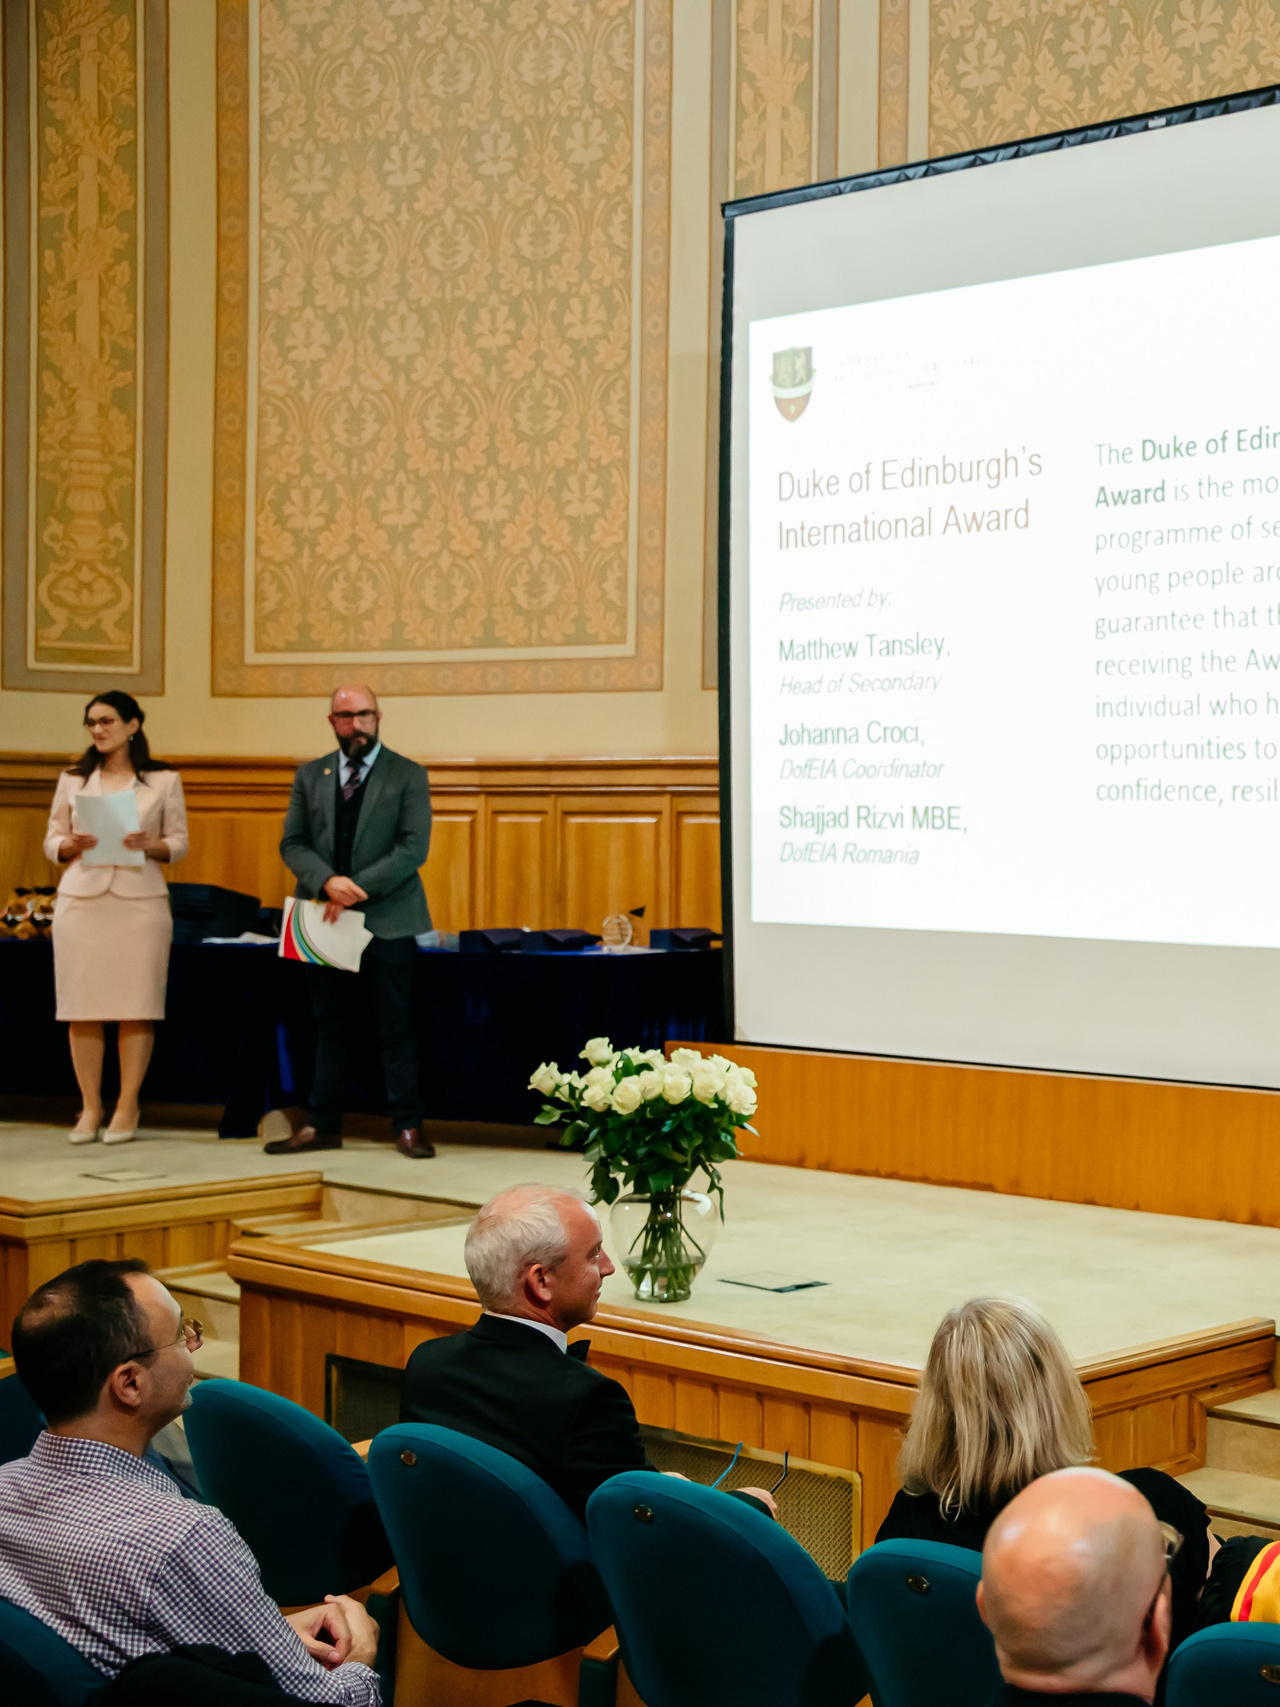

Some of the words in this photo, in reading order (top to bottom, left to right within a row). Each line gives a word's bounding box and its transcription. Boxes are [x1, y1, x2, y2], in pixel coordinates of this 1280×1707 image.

[1095, 443, 1133, 466] The
[1142, 435, 1197, 462] Duke
[1205, 430, 1229, 455] of
[778, 469, 839, 501] Duke
[849, 462, 872, 493] of
[882, 446, 1043, 490] Edinburgh's
[1095, 479, 1165, 508] Award
[1174, 478, 1190, 501] is
[1197, 475, 1234, 499] the
[779, 507, 932, 550] International
[942, 498, 1029, 536] Award
[1096, 525, 1223, 555] programme
[1231, 515, 1253, 540] of
[1095, 572, 1160, 597] young
[1168, 561, 1244, 593] people
[779, 588, 864, 613] Presented
[1095, 610, 1204, 640] guarantee
[1213, 605, 1258, 629] that
[779, 637, 859, 662] Matthew
[865, 632, 950, 661] Tansley,
[1096, 651, 1192, 679] receiving
[1200, 649, 1237, 673] the
[780, 674, 824, 695] Head
[827, 672, 845, 693] of
[848, 671, 942, 695] Secondary
[1096, 693, 1200, 718] individual
[1209, 692, 1257, 716] who
[778, 723, 859, 746] Johanna
[866, 720, 924, 747] Croci,
[1096, 736, 1247, 766] opportunities
[1254, 738, 1277, 760] to
[842, 757, 945, 779] Coordinator
[1096, 777, 1223, 808] confidence,
[779, 804, 850, 836] Shajjad
[856, 804, 904, 830] Rizvi
[912, 805, 967, 834] MBE,
[841, 841, 920, 865] Romania
